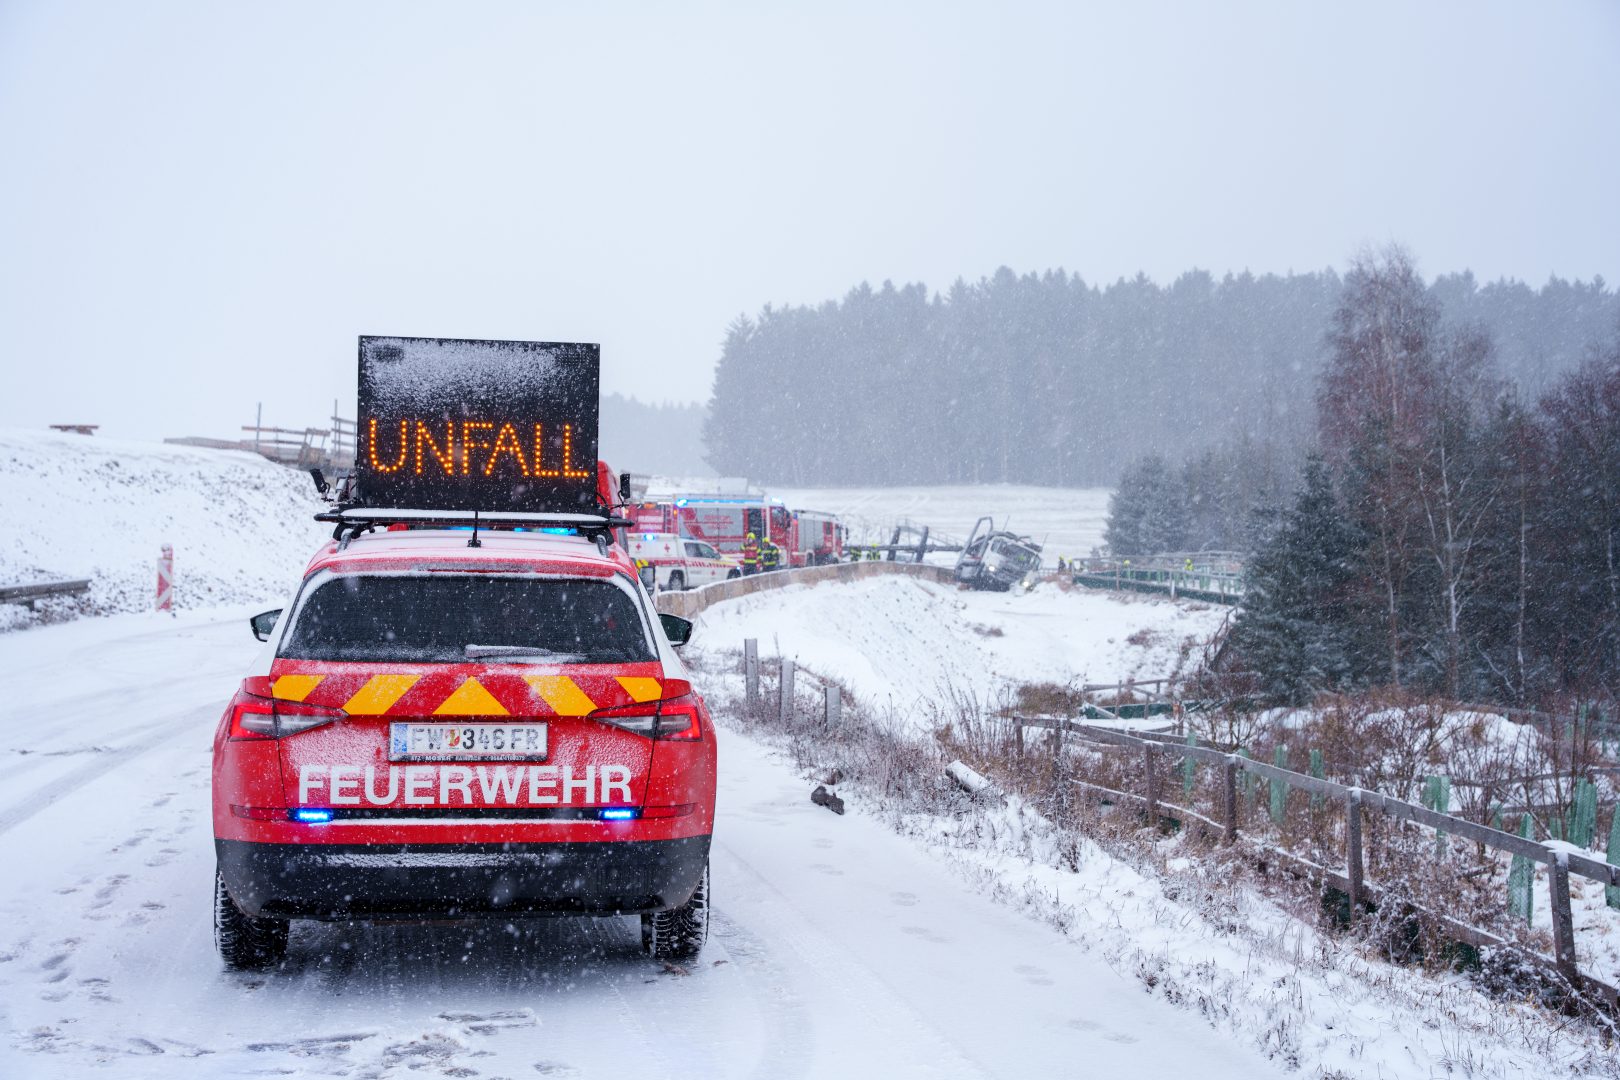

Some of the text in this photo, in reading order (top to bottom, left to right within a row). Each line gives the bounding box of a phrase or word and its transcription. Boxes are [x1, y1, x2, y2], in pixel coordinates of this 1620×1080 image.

[368, 418, 589, 478] UNFALL
[412, 728, 443, 749] FW
[298, 764, 633, 805] FEUERWEHR
